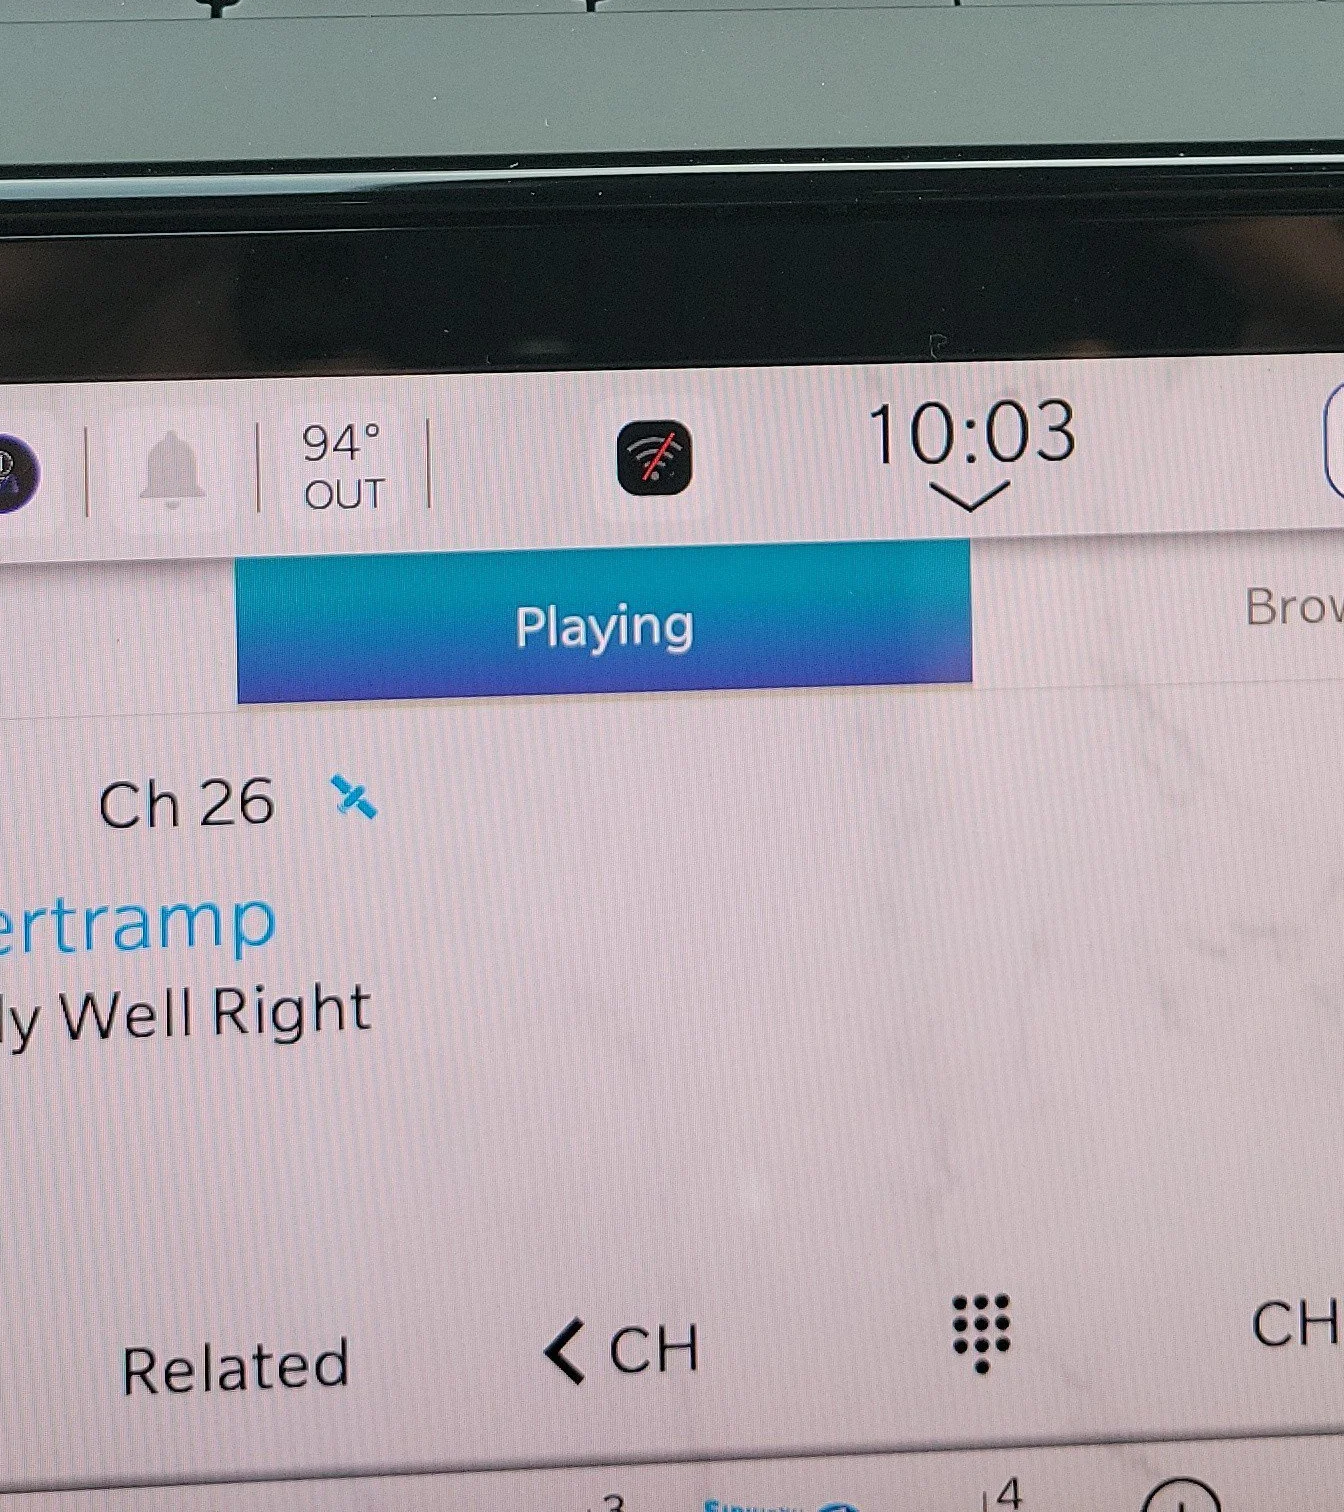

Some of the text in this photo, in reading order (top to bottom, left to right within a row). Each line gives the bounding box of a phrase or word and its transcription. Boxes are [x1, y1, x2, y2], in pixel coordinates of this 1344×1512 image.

[302, 422, 380, 462] 94°
[869, 397, 1078, 467] 10:03
[305, 478, 387, 510] OUT
[515, 602, 696, 658] Playing
[99, 777, 277, 830] Ch 26
[59, 988, 193, 1042] Well
[213, 982, 373, 1044] Right
[1253, 1296, 1339, 1347] CH
[123, 1336, 350, 1396] Related
[610, 1322, 699, 1374] CH
[997, 1477, 1023, 1510] 4
